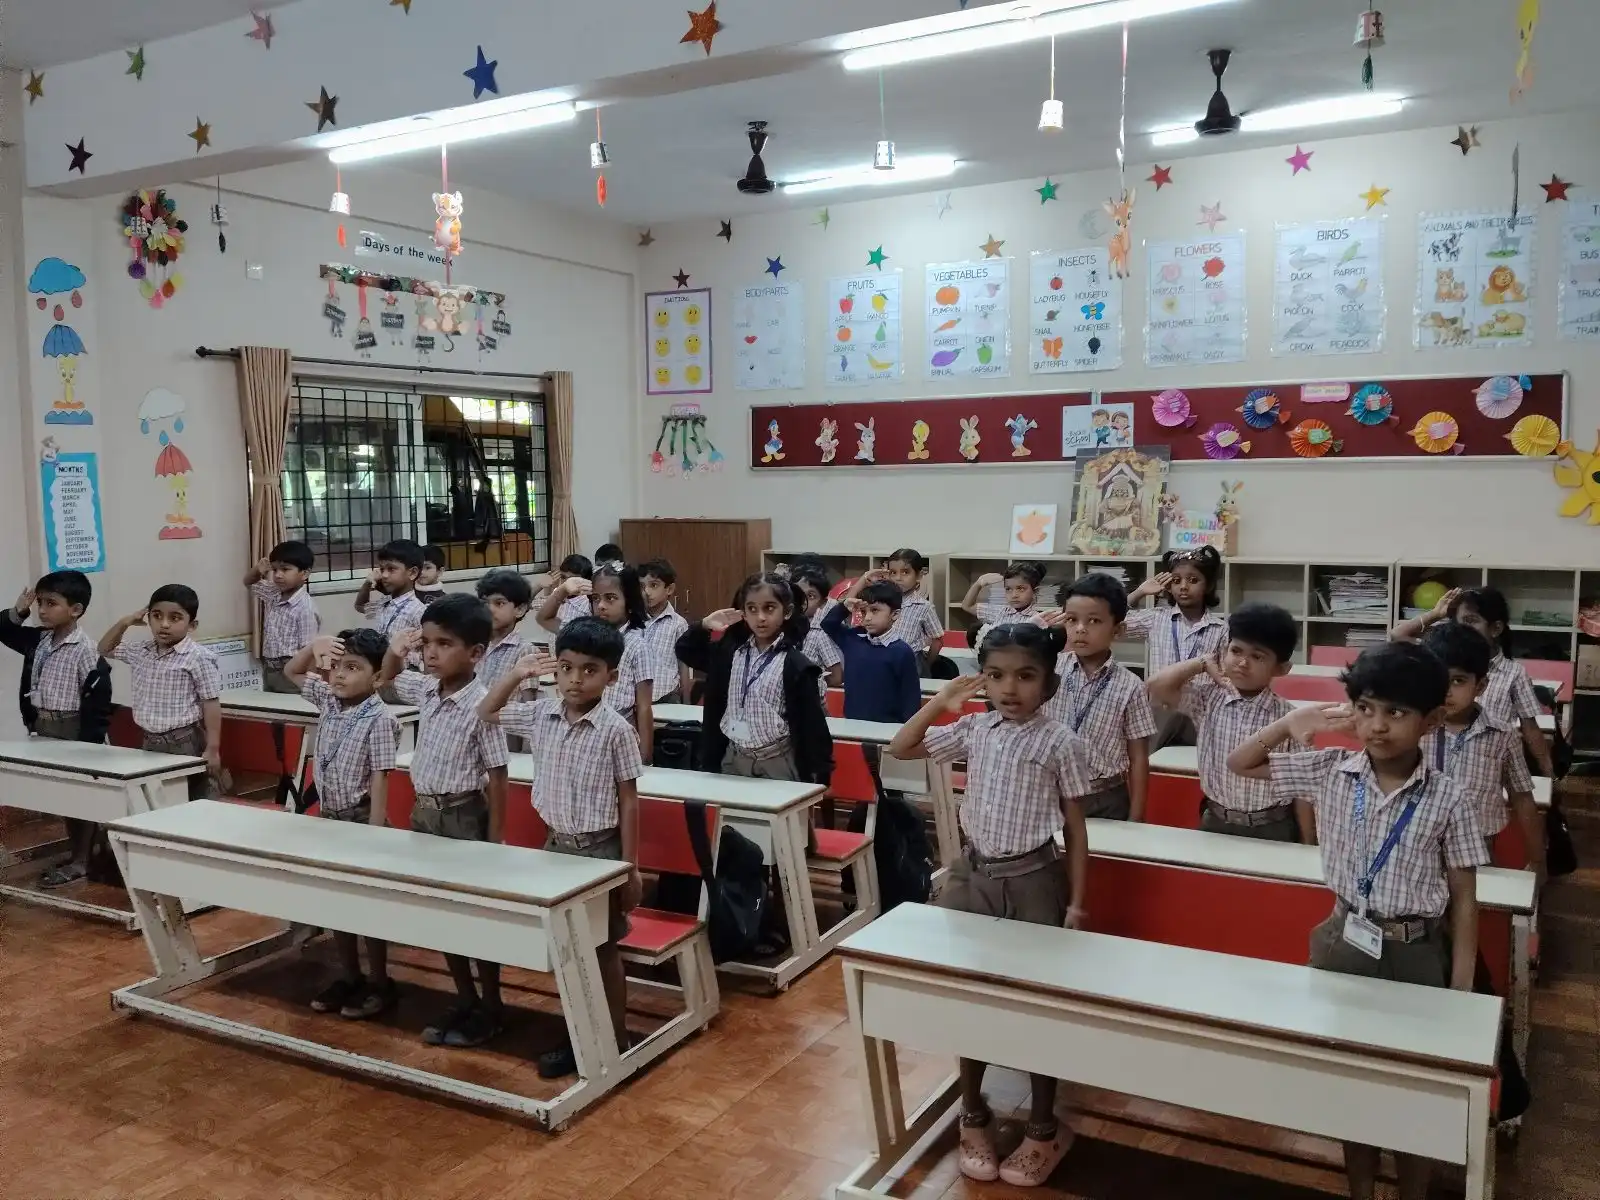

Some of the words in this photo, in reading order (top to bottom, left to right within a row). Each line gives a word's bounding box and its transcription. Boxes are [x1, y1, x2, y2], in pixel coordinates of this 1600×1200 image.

[1464, 219, 1480, 229] AND
[1316, 228, 1350, 241] BIRDS
[365, 237, 390, 252] Days
[393, 246, 403, 256] of
[408, 248, 424, 258] the
[427, 255, 453, 266] week
[1174, 242, 1223, 257] FLOWERS
[1580, 250, 1599, 260] BUS
[1058, 255, 1097, 267] INSECTS
[934, 268, 989, 282] VEGETABLES
[1290, 272, 1313, 281] DUCK
[1333, 266, 1367, 277] PARROT
[847, 280, 875, 291] FRUITS
[1205, 281, 1225, 289] ROSE
[745, 286, 789, 298] BODYPARTS
[1034, 293, 1066, 304] LADYBUG
[1075, 290, 1109, 301] HOUSEFLY
[1577, 289, 1600, 298] TRUC
[932, 306, 961, 315] PUMPKIN
[1341, 303, 1366, 313] COCK
[1034, 327, 1052, 336] SNAIL
[1073, 322, 1112, 333] HONEYBEE
[1329, 340, 1371, 349] PEACOCK
[1033, 360, 1068, 370] BUTTERFLY
